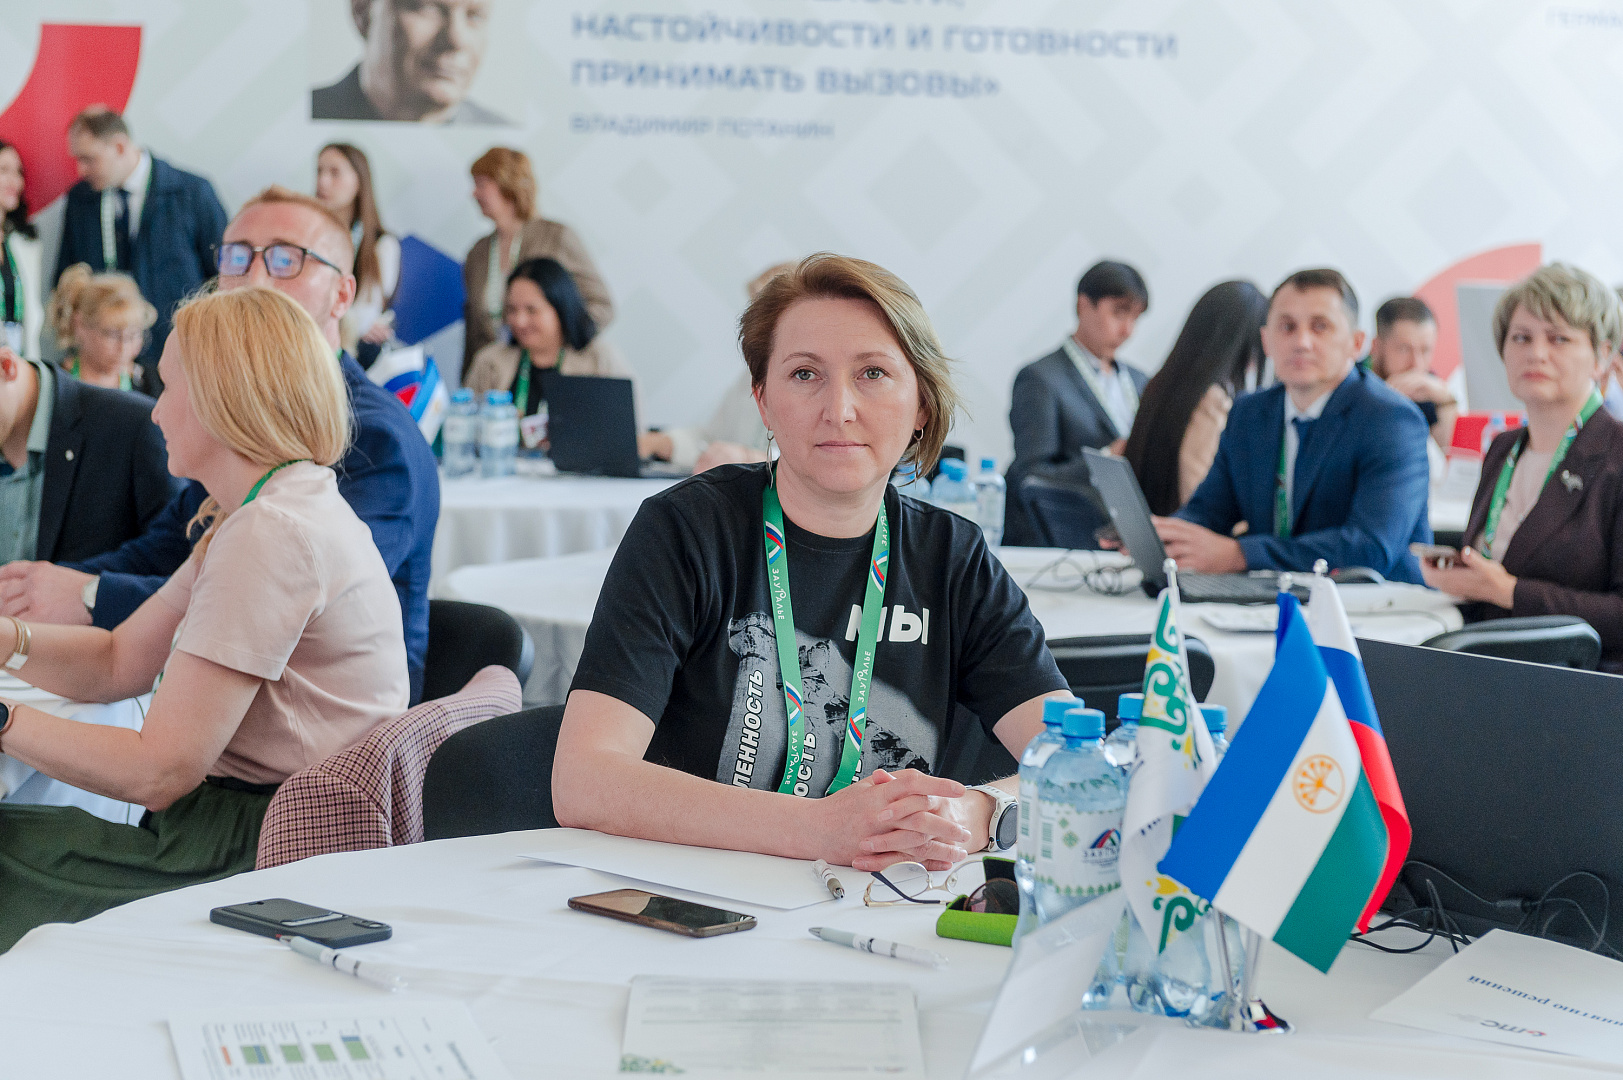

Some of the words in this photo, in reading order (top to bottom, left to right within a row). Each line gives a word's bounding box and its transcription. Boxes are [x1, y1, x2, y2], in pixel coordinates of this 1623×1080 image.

[572, 11, 896, 49] НАСТОЙЧИВОСТИ
[906, 24, 932, 49] И
[944, 25, 1178, 59] ГОТОВНОСТИ
[572, 60, 805, 93] ПРИНИМАТЬ
[772, 568, 787, 620] ЗАУРАЛЬЕ
[857, 651, 872, 703] ЗАУРАЛЬЕ
[784, 730, 800, 785] ЗАУРАЛЬЕ
